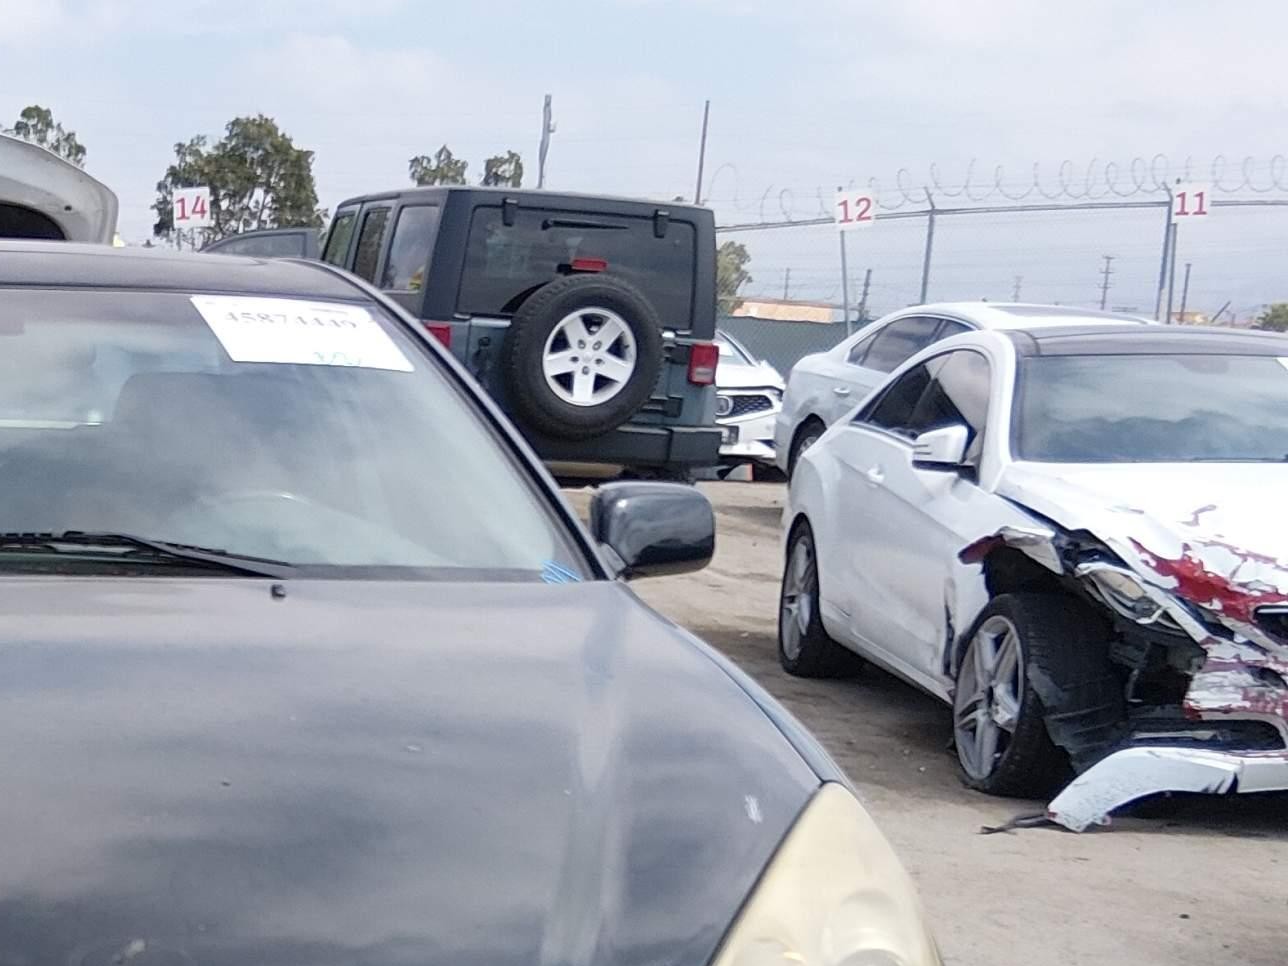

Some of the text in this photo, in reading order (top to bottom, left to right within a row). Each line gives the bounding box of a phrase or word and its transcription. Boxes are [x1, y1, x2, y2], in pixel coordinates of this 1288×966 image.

[175, 196, 208, 220] 14
[838, 197, 872, 223] 12
[1174, 191, 1208, 216] 11
